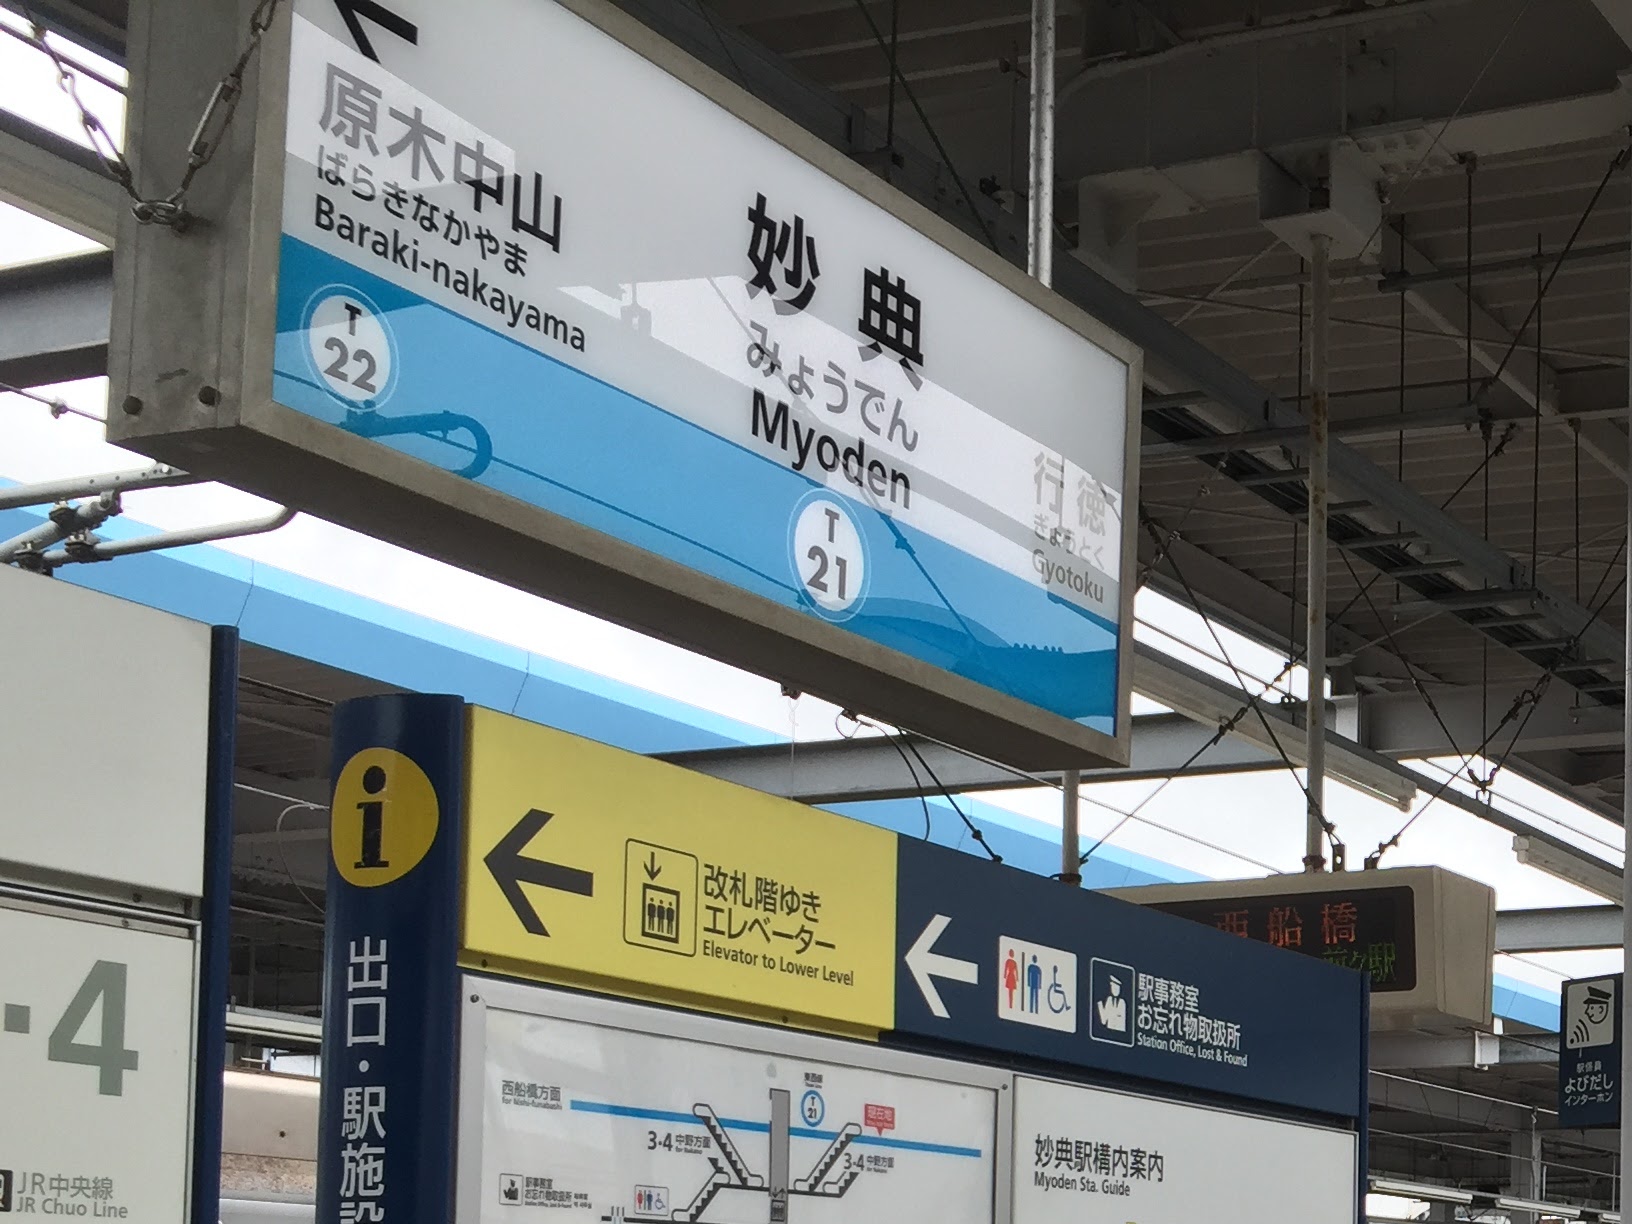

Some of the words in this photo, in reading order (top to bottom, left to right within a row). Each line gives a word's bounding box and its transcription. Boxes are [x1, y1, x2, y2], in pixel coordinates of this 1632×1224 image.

[319, 63, 562, 253] 原木中山
[317, 144, 528, 277] ばらきなかやま
[314, 194, 586, 352] Baraki-nakayama
[747, 192, 924, 391] 妙典
[345, 303, 361, 336] T
[323, 337, 377, 394] 22
[746, 321, 919, 452] みょうでん
[751, 389, 911, 510] Myoden
[1033, 451, 1107, 537] 行徳
[824, 508, 840, 543] T
[806, 545, 848, 601] 21
[1032, 548, 1104, 603] Gyotoku
[703, 863, 822, 923] 改札階ゆき
[703, 905, 836, 955] エレベーター
[703, 940, 758, 968] Elevator
[762, 950, 776, 969] to
[780, 953, 820, 978] Lower
[822, 962, 854, 987] Level
[1138, 973, 1200, 1012] 駅事務室
[1137, 1032, 1167, 1053] Station
[1169, 1039, 1196, 1058] Office,
[1197, 1044, 1215, 1060] Lost
[1216, 1048, 1223, 1061] &
[1224, 1049, 1247, 1067] Found
[1138, 1003, 1241, 1050] お忘れ物取扱所
[1564, 1073, 1613, 1094] よびだし
[1576, 1061, 1602, 1074] 駅係員
[1564, 1092, 1613, 1107] インターホン
[1033, 1134, 1164, 1183] 妙典駅構内案内
[17, 1171, 114, 1200] JR中央線
[17, 1197, 36, 1214] JR
[41, 1199, 87, 1217] Chuo
[93, 1200, 128, 1219] Line
[1033, 1171, 1077, 1192] Myoden
[1079, 1176, 1099, 1193] Sta.
[1102, 1179, 1131, 1196] Guide
